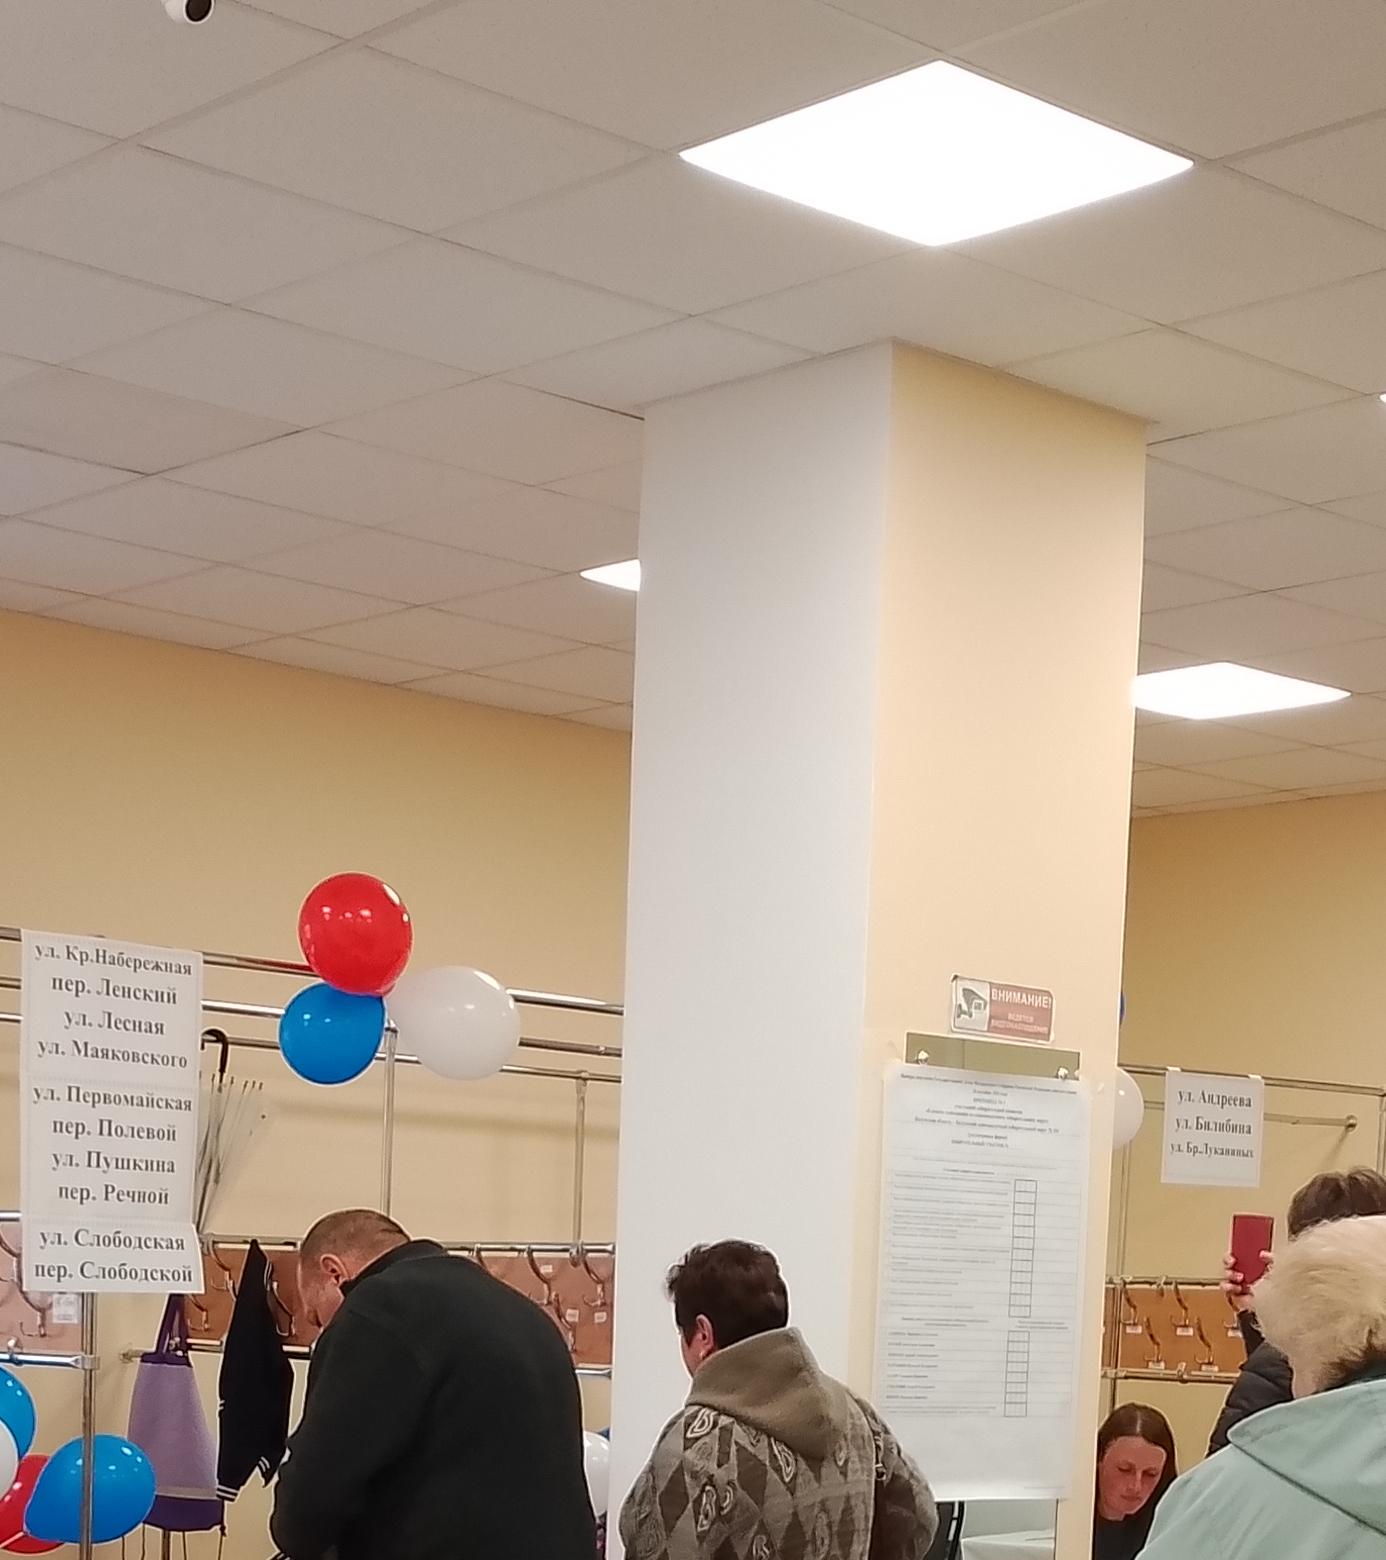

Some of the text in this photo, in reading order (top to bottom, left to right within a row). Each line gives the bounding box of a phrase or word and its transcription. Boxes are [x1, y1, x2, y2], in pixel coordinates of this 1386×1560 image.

[35, 945, 191, 975] ул. Кр.Набережная
[52, 977, 177, 1004] пер. Ленский
[991, 988, 1051, 1009] ВНИМАНИЕ!
[64, 1011, 164, 1035] ул. Лесная
[38, 1040, 187, 1068] ул. Маяковского
[33, 1086, 191, 1111] ул. Первомайская
[1178, 1090, 1251, 1108] ул. Андреева
[53, 1119, 176, 1141] пер. Полевой
[1175, 1116, 1251, 1135] ул. Билибина
[52, 1151, 175, 1173] ул. Пушкина
[59, 1184, 169, 1205] пер. Речной
[39, 1229, 185, 1250] ул. Слободская
[35, 1261, 192, 1283] пер. Слободской
